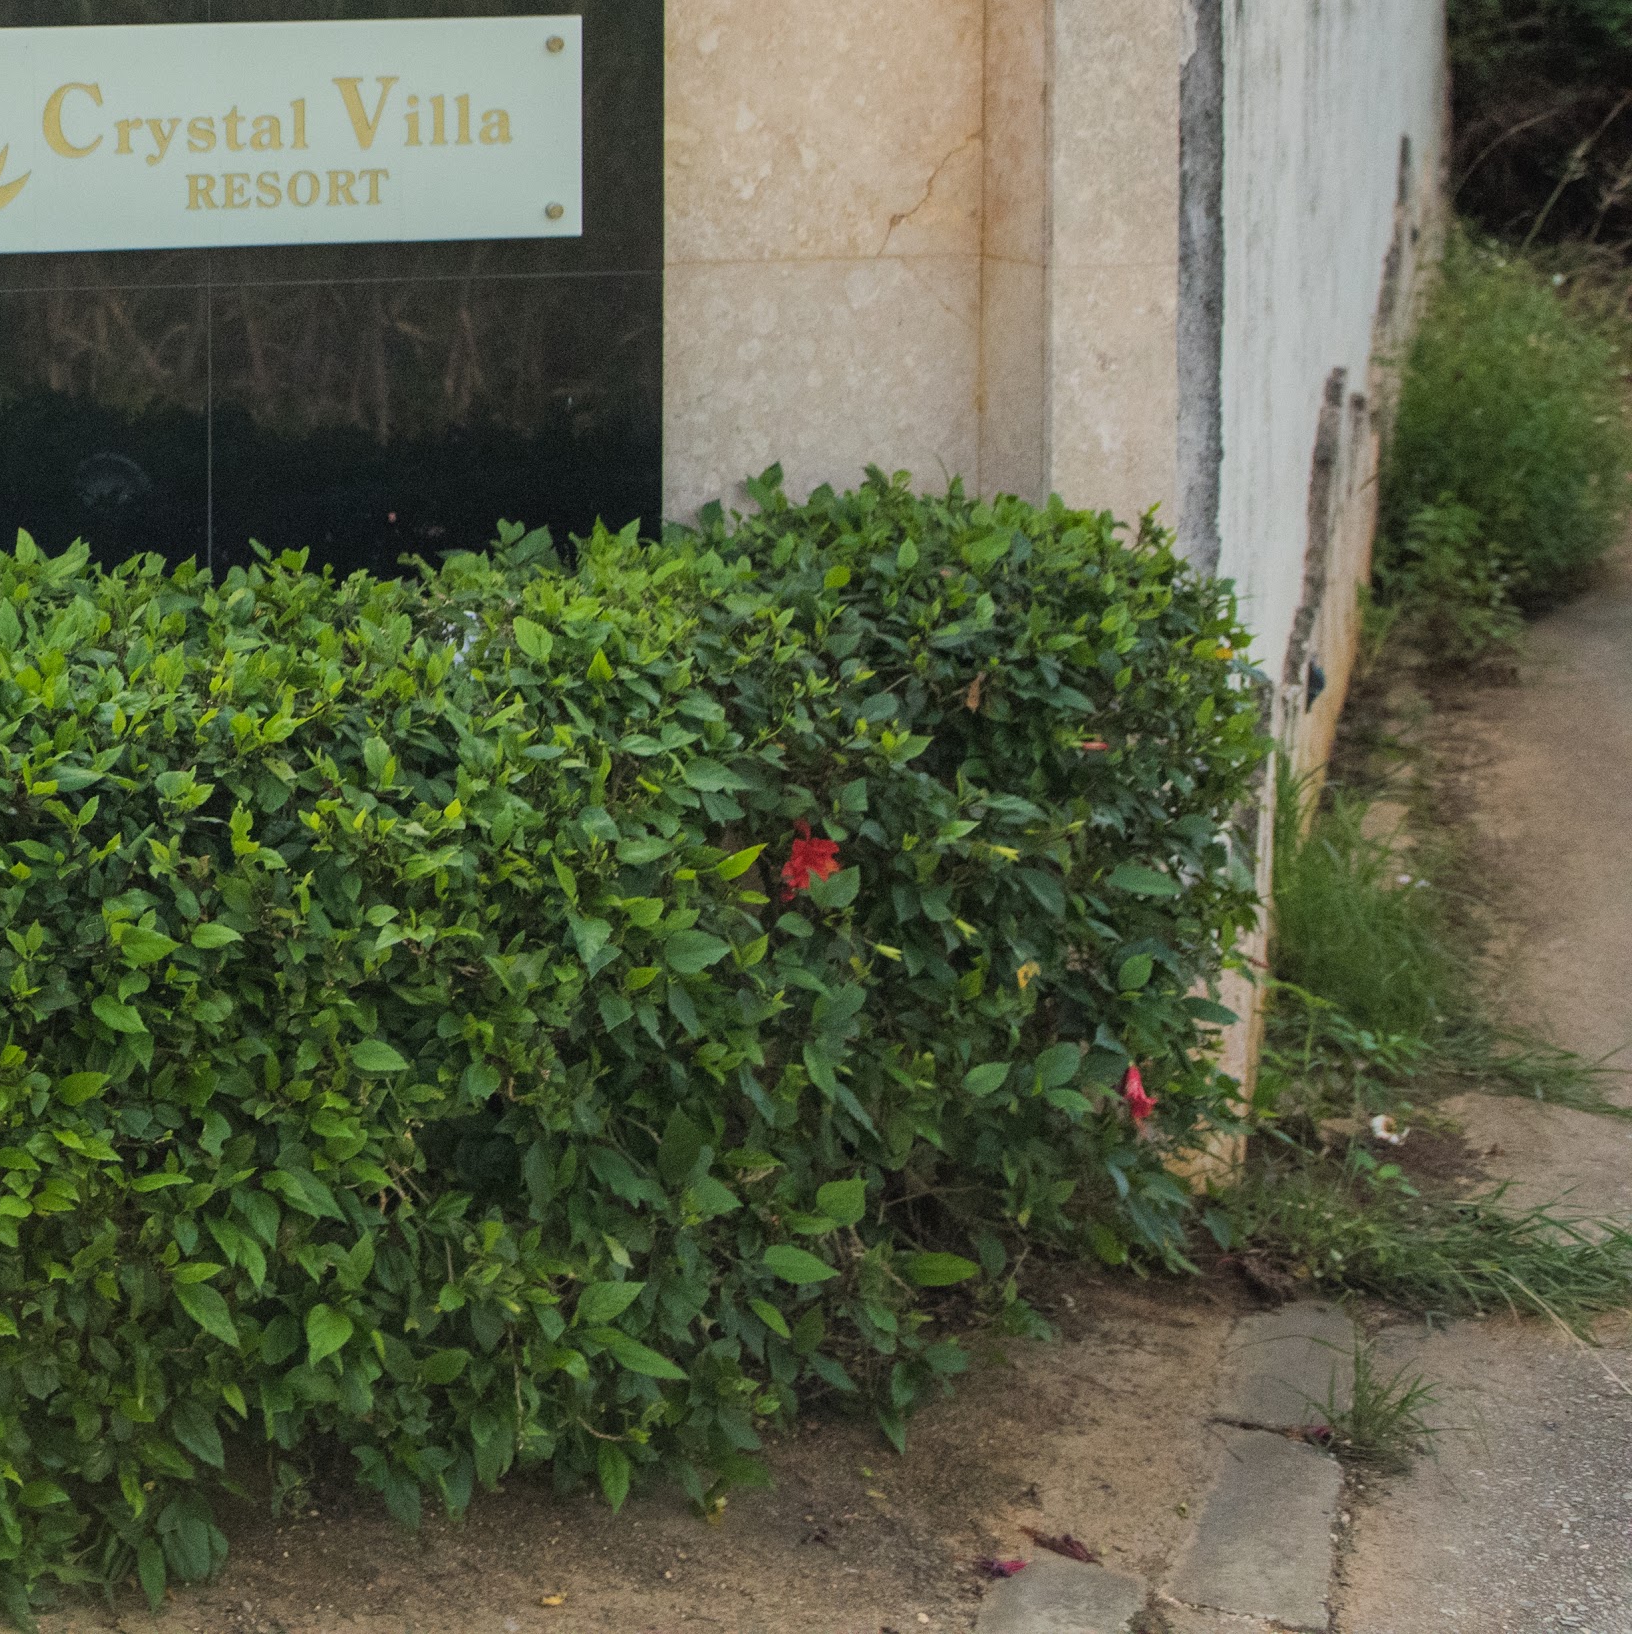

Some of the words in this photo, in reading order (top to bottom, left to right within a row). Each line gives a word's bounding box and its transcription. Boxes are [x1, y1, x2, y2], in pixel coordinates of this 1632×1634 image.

[42, 81, 308, 166] Crystal
[332, 76, 512, 150] Villa
[185, 169, 390, 211] RESORT
